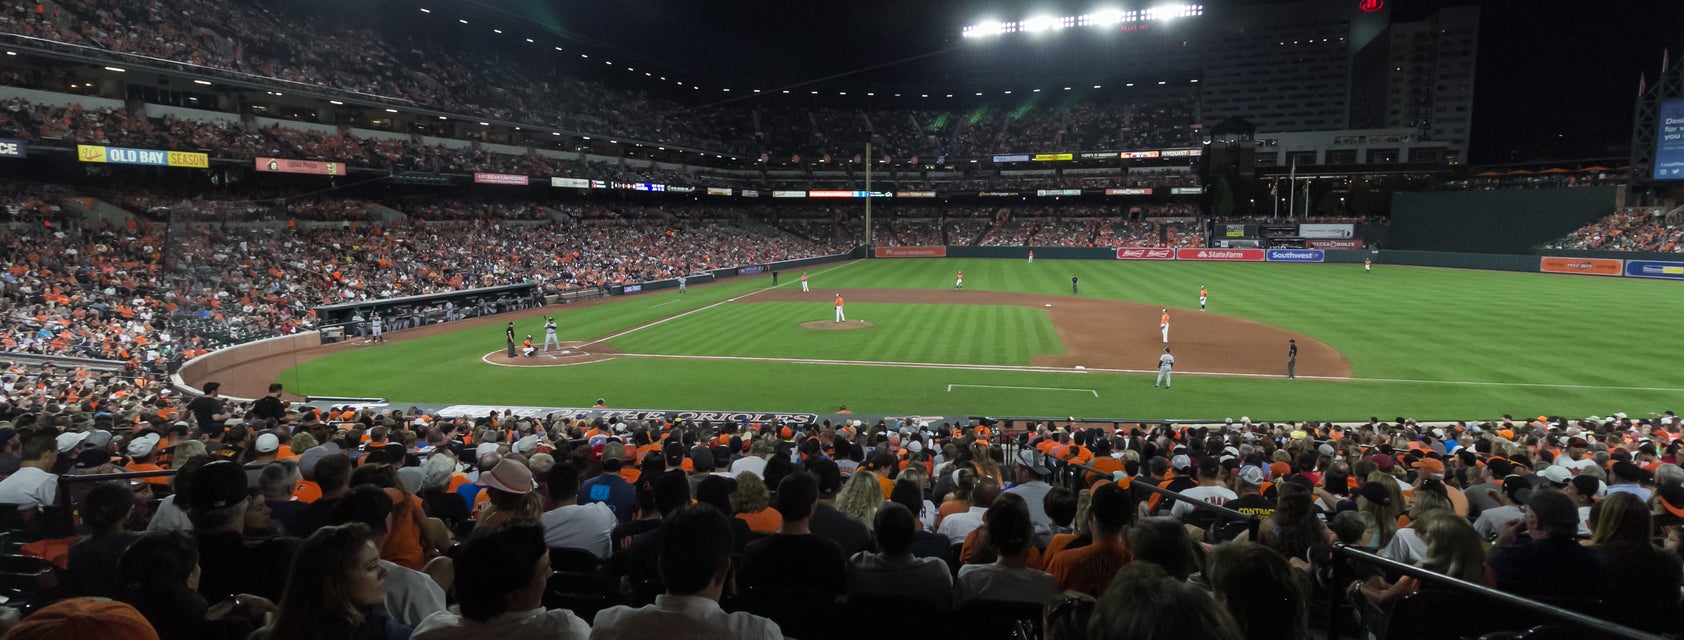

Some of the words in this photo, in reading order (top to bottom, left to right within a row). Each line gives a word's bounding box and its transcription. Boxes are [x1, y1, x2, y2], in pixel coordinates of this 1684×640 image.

[110, 149, 137, 162] OLD
[139, 151, 164, 164] BAY
[171, 153, 206, 166] SEASON
[1272, 251, 1312, 259] Southwest
[599, 410, 666, 421] THE
[677, 412, 811, 424] ORIOLES
